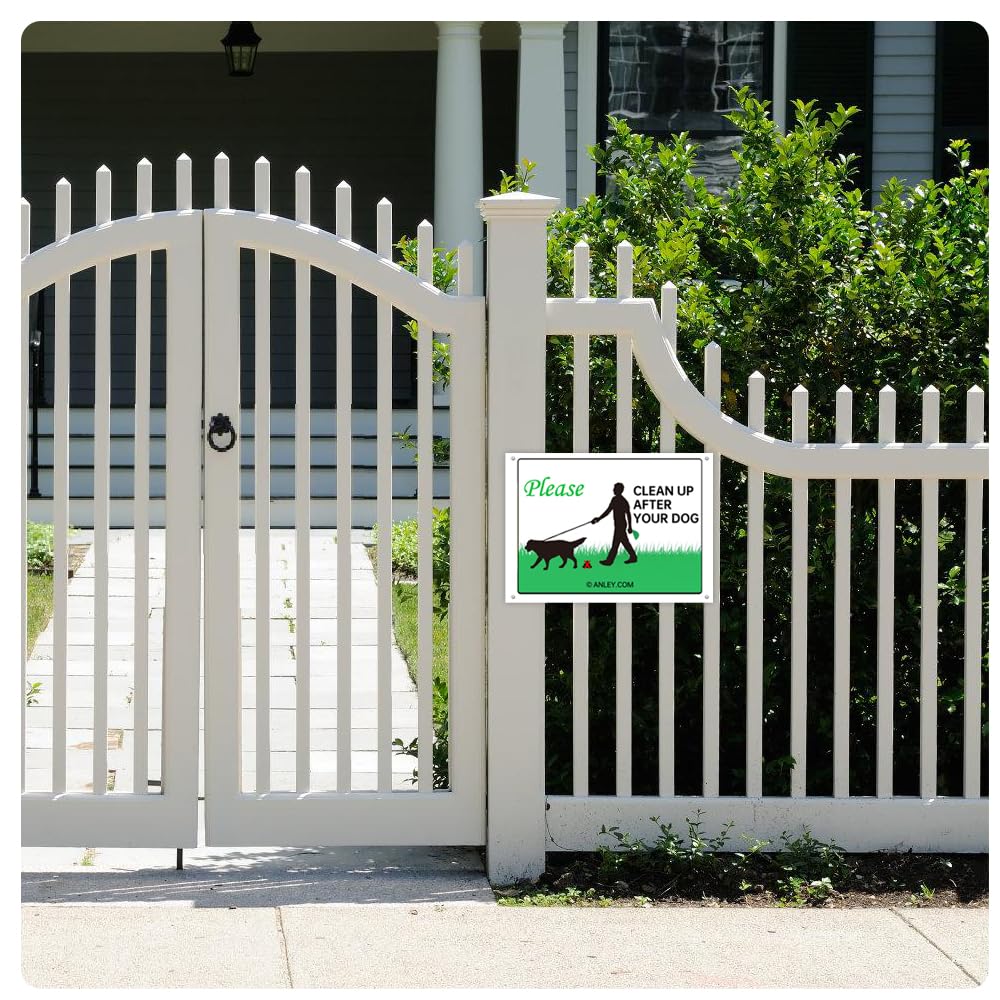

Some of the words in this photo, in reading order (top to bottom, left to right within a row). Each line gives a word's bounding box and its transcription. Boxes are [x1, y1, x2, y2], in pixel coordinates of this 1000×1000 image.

[524, 477, 584, 497] Please
[633, 486, 674, 496] CLEAN
[677, 486, 694, 496] UP
[634, 500, 672, 510] AFTER
[634, 513, 668, 523] YOUR
[672, 513, 699, 523] DOG
